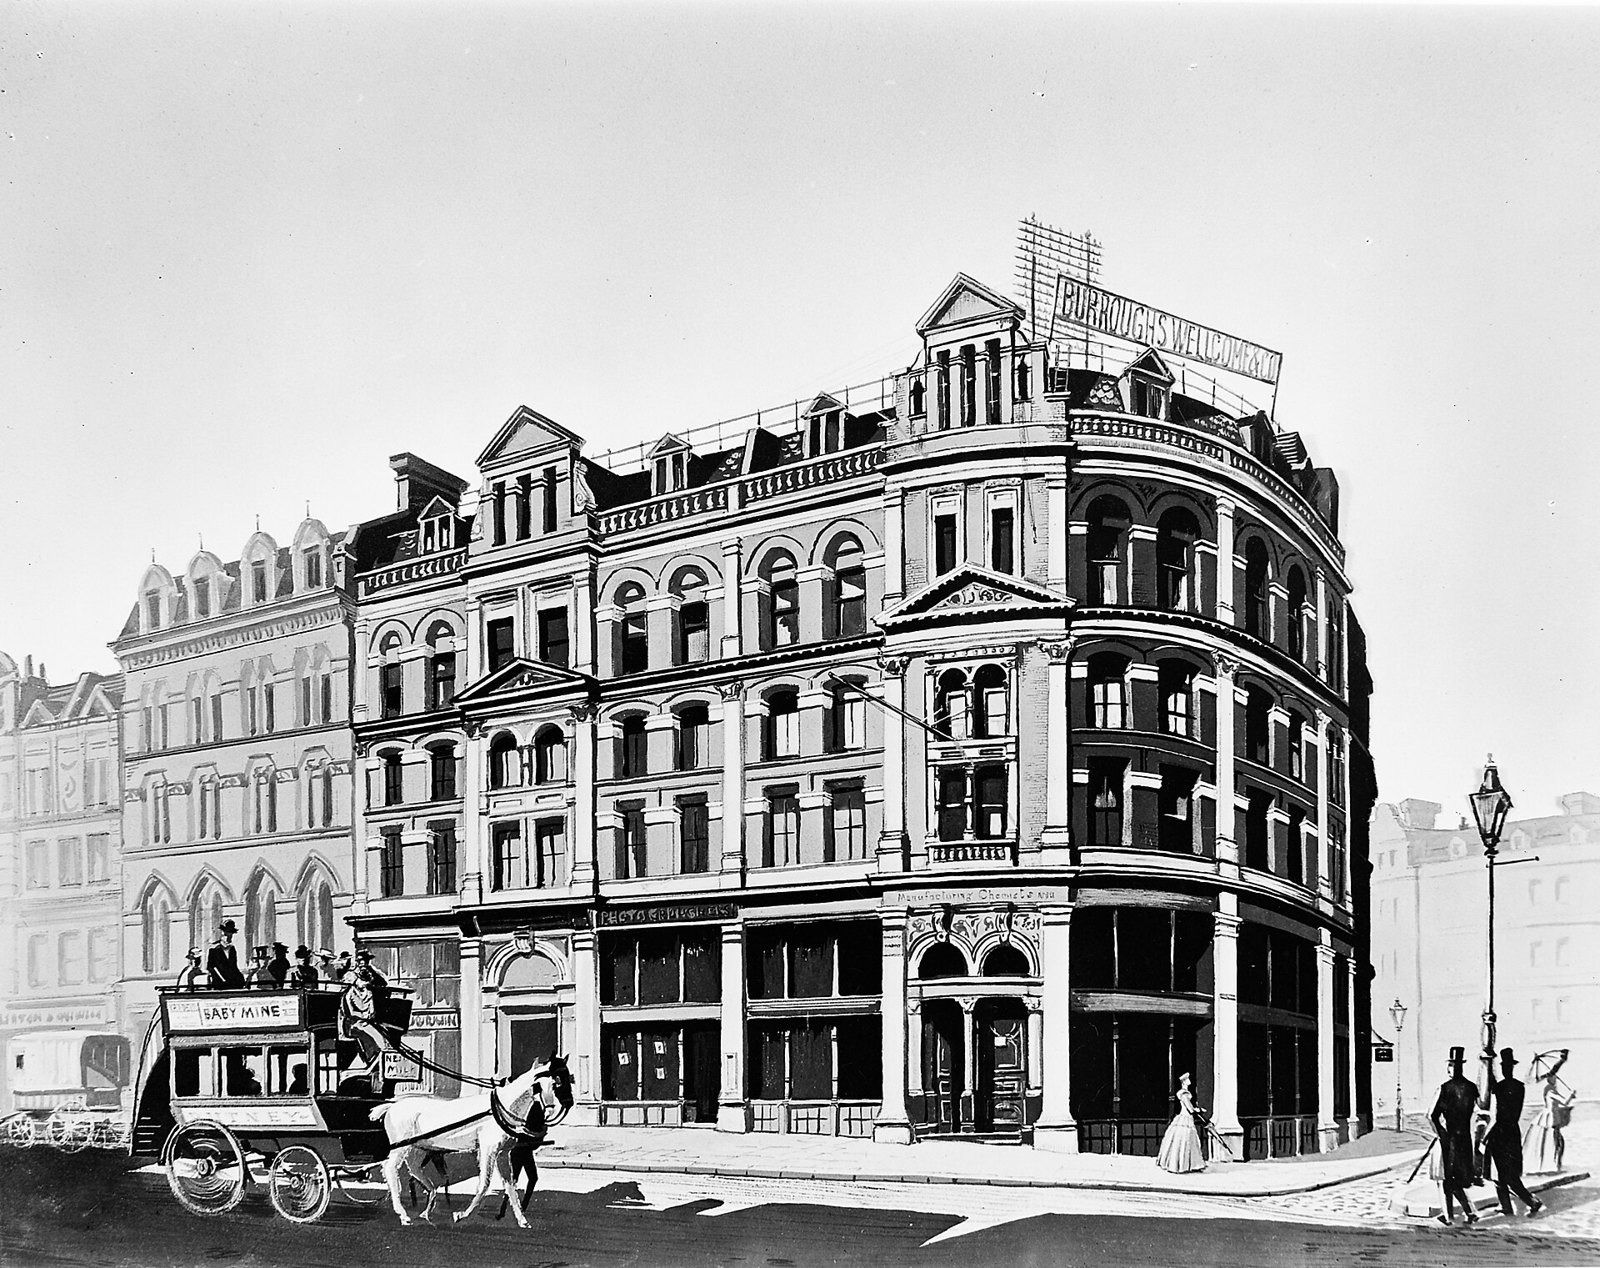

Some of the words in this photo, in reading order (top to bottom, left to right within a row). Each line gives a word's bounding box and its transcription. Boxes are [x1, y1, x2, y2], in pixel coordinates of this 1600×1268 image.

[1061, 279, 1168, 348] BURROUGHS
[897, 890, 974, 902] Manufacturing
[203, 1007, 237, 1020] BABY
[240, 1004, 281, 1019] MINE
